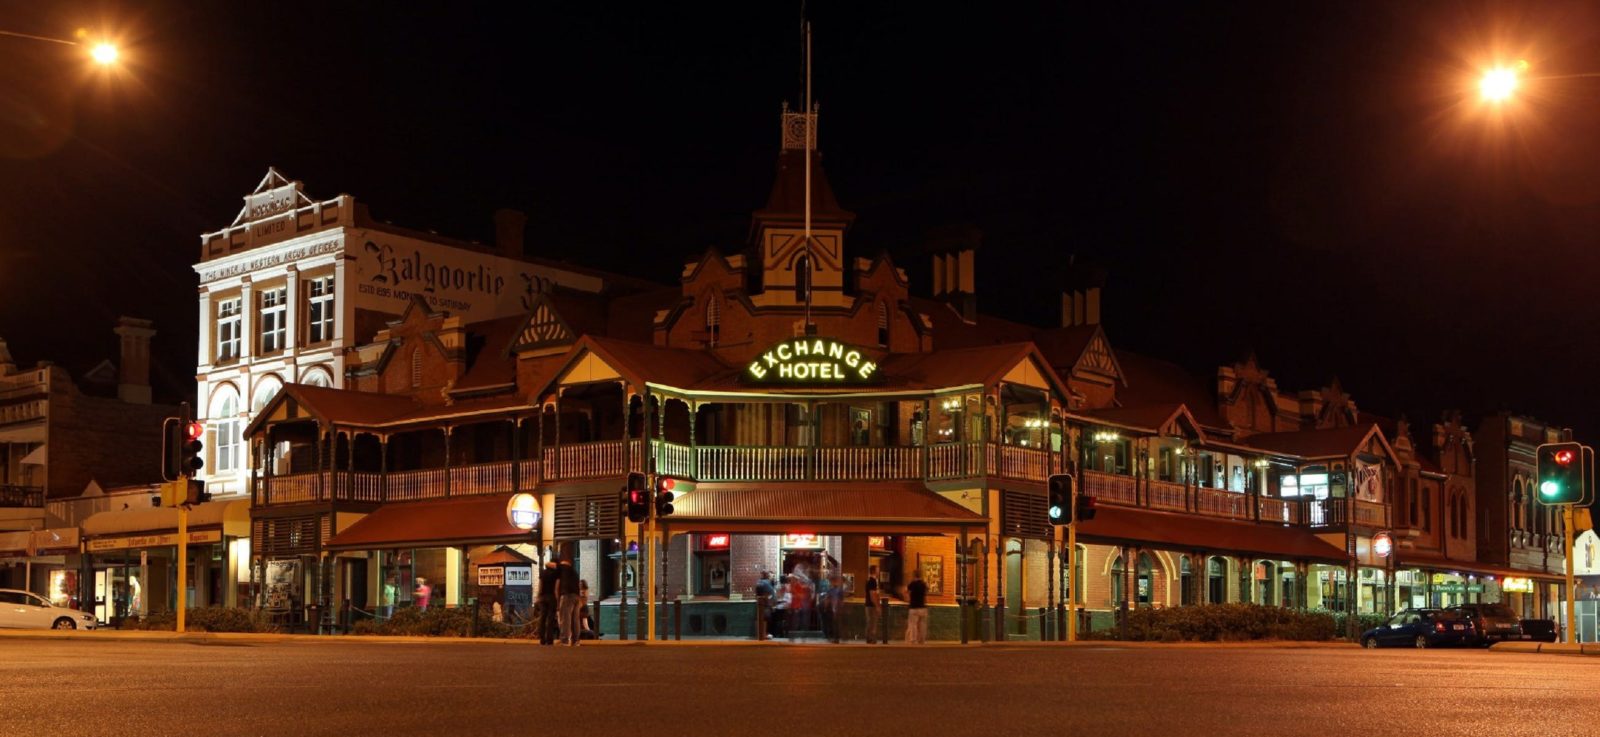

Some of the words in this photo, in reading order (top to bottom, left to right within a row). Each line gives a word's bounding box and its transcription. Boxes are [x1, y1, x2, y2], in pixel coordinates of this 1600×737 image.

[205, 270, 217, 282] THE
[220, 264, 240, 278] MINER
[251, 254, 280, 270] WESTERN
[309, 239, 339, 256] OFFICES
[364, 241, 504, 295] Kalgoorlie
[748, 340, 877, 379] EXCHANGE
[779, 362, 845, 379] HOTEL
